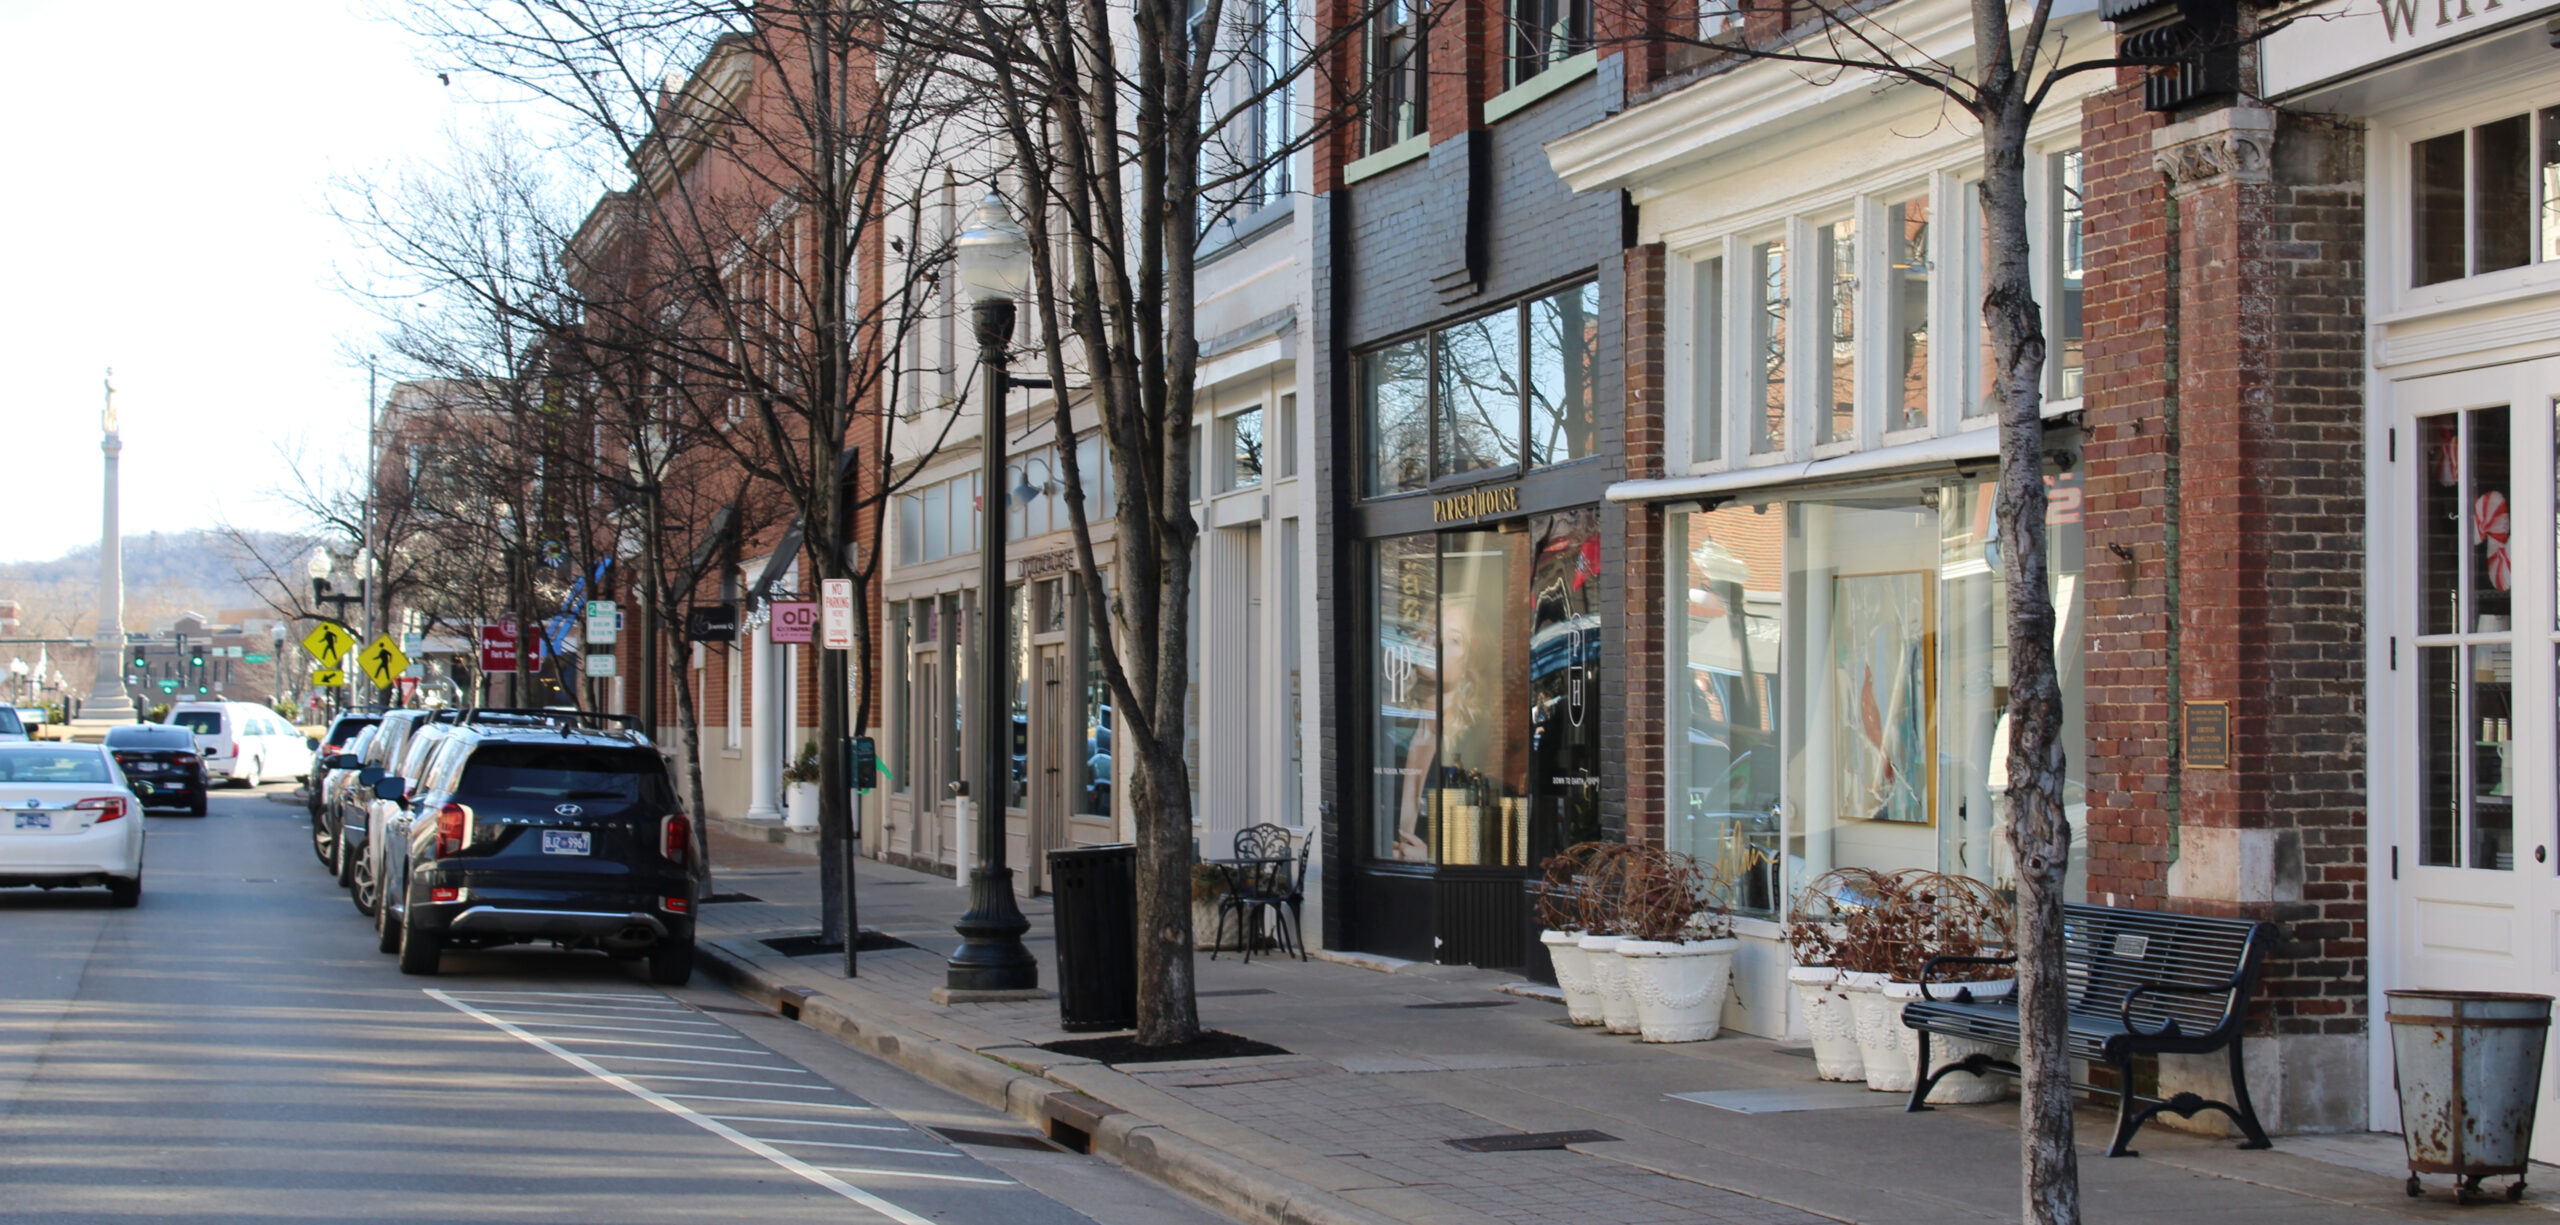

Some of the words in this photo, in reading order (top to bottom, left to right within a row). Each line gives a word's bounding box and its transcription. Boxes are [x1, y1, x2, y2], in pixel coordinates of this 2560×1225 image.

[1433, 493, 1474, 523] PARKER
[1478, 486, 1519, 517] HOUSE
[831, 583, 843, 596] NO
[825, 596, 850, 609] PARKING
